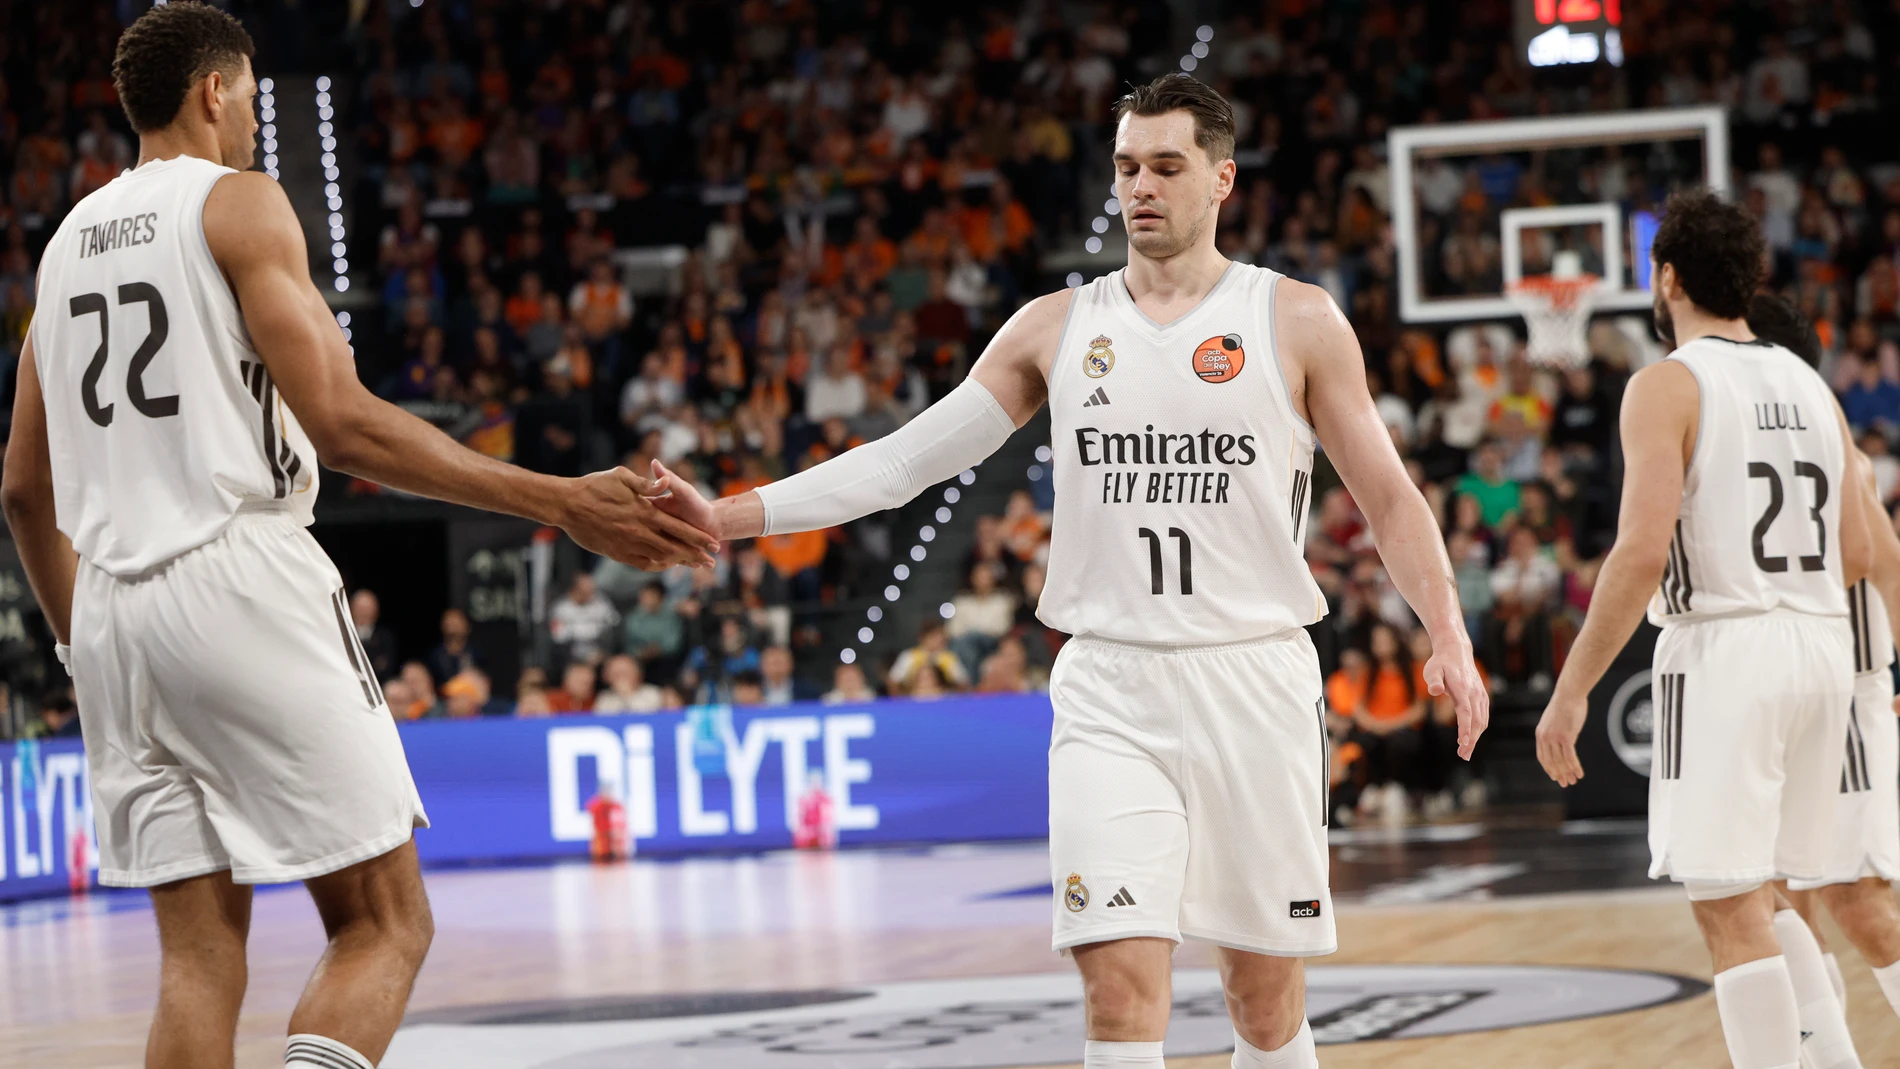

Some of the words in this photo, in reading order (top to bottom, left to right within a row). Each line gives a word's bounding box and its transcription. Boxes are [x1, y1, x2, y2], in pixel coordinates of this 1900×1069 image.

[79, 212, 158, 260] TAVARES
[69, 281, 180, 428] 22
[1202, 355, 1227, 363] Copa
[1213, 362, 1231, 371] Rey
[1755, 403, 1808, 430] LLULL
[1075, 424, 1257, 466] Emirates
[1103, 472, 1139, 504] FLY
[1145, 472, 1230, 504] BETTER
[1747, 460, 1829, 573] 23
[1138, 526, 1193, 595] 11
[1292, 907, 1314, 917] acb
